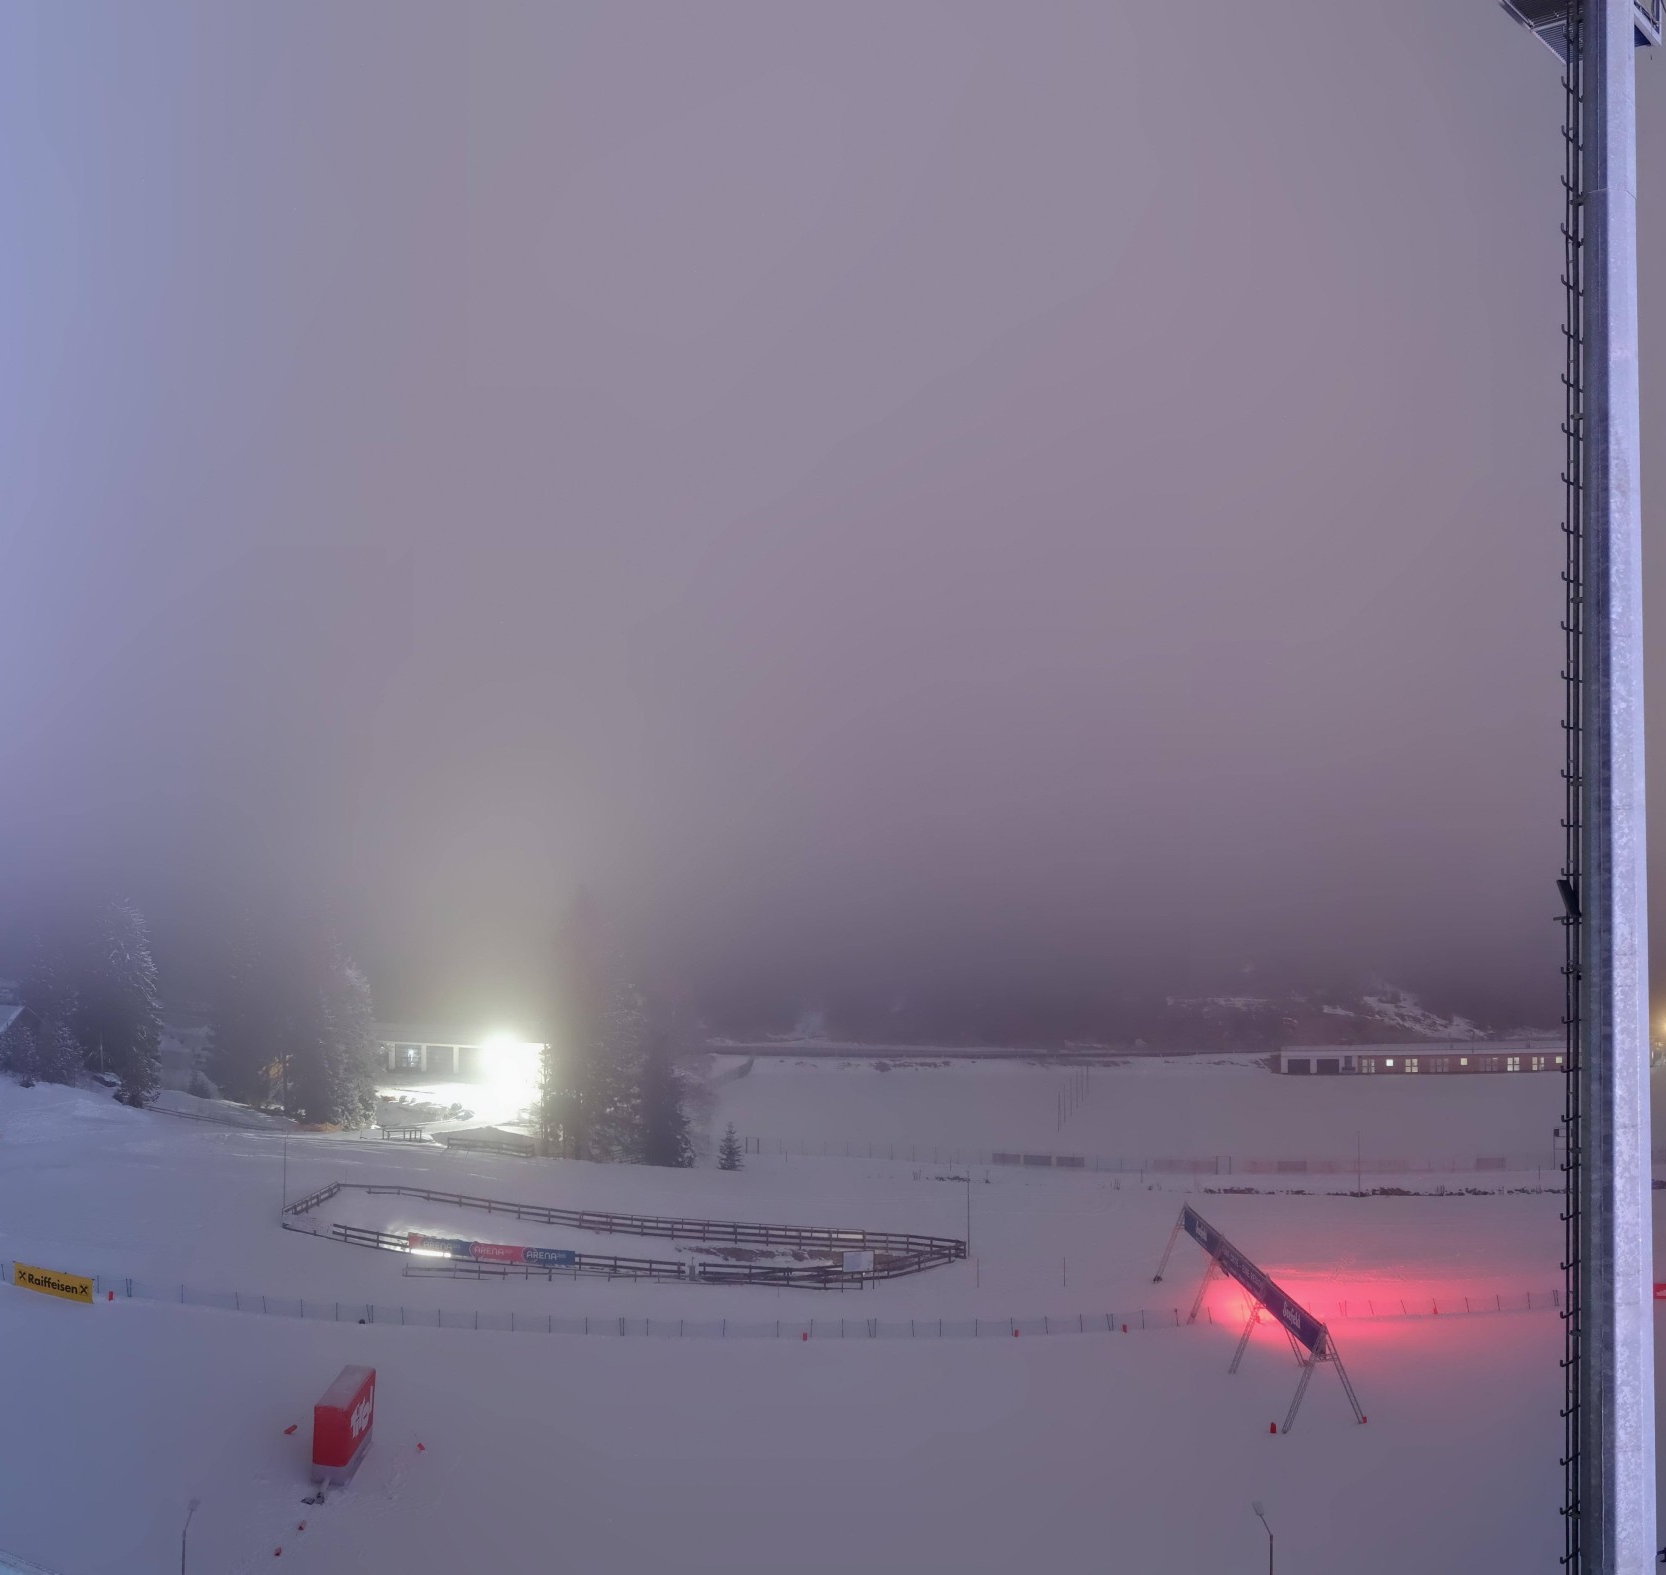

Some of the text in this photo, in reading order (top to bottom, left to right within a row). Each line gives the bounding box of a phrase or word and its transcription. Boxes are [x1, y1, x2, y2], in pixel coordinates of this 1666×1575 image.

[474, 1246, 504, 1255] ARENA
[526, 1251, 557, 1260] ARENA
[27, 1273, 78, 1294] Raiffeisen
